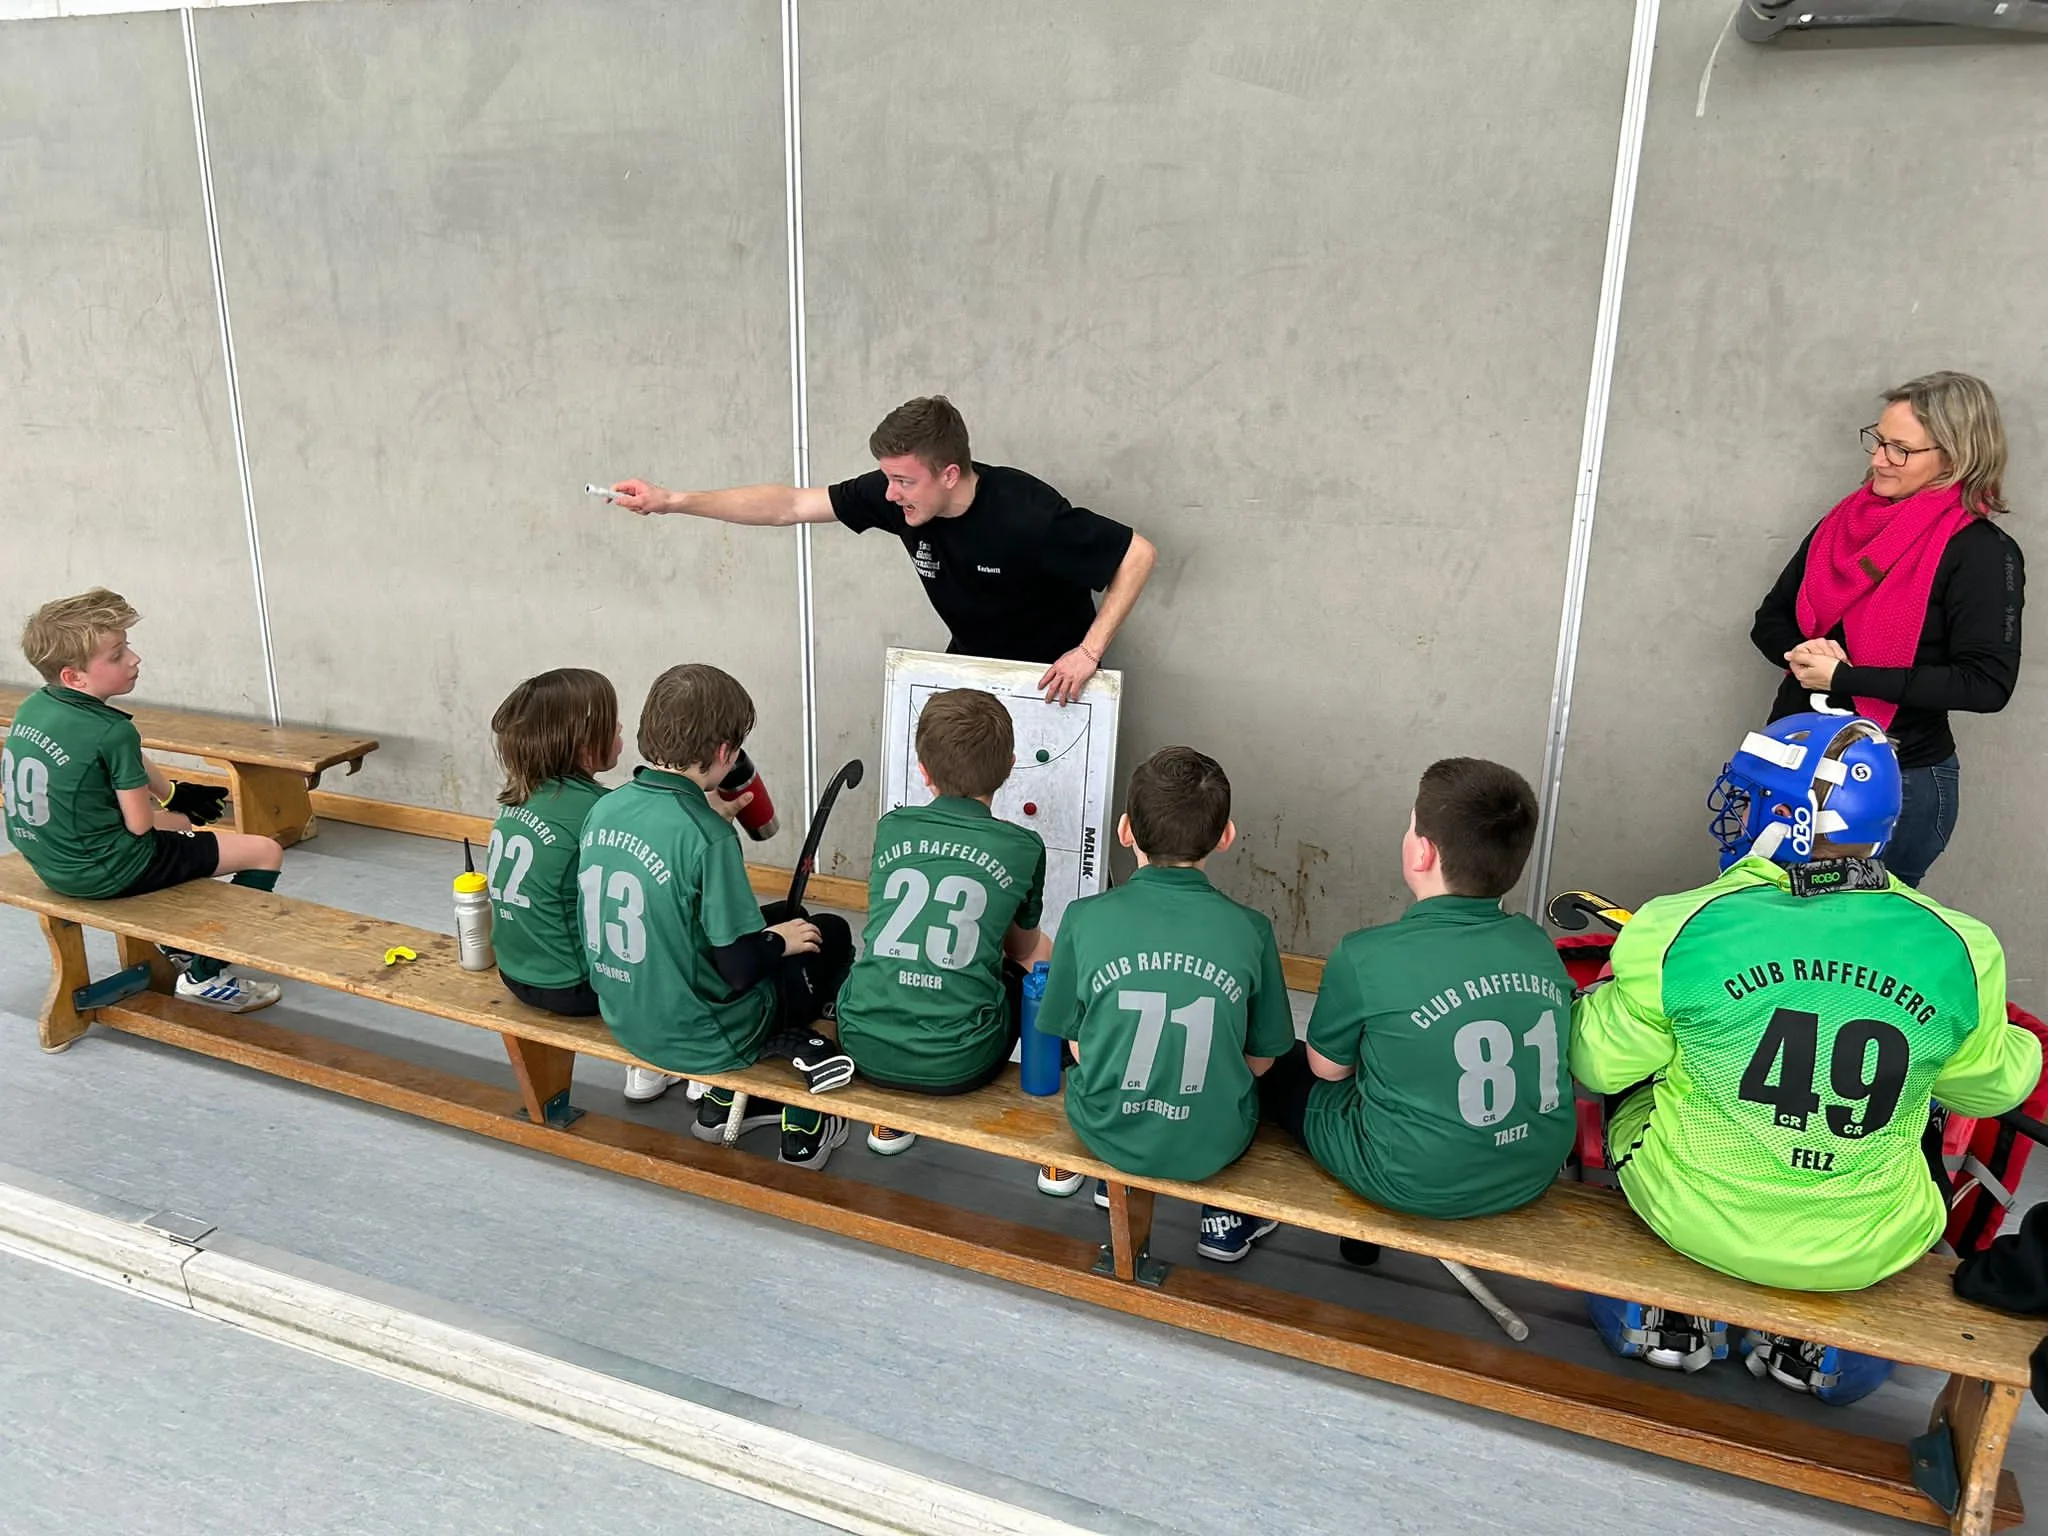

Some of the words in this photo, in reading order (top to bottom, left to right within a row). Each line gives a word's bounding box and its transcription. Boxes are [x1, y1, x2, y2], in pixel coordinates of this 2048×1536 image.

[13, 724, 70, 766] RAFFELBERG
[503, 806, 557, 846] RAFFELBERG
[1793, 807, 1811, 856] OBO
[488, 829, 534, 908] 22
[598, 828, 671, 885] RAFFELBERG
[878, 840, 912, 869] CLUB
[919, 839, 1014, 889] RAFFELBERG
[1082, 826, 1096, 878] MALIK
[1811, 872, 1841, 884] ROBO
[578, 864, 646, 964] 13
[873, 868, 988, 970] 23
[889, 948, 901, 956] CR
[943, 957, 954, 965] CR
[899, 970, 942, 990] BECKER
[1092, 956, 1132, 993] CLUB
[1138, 951, 1243, 1004] RAFFELBERG
[1411, 988, 1463, 1030] CLUB
[1464, 973, 1562, 1007] RAFFELBERG
[1724, 961, 1785, 1000] CLUB
[1793, 959, 1937, 1026] RAFFELBERG
[1118, 990, 1216, 1094] 71
[1127, 1080, 1141, 1088] CR
[1453, 1009, 1560, 1127] 81
[1738, 1007, 1910, 1139] 49
[1122, 1099, 1190, 1120] OSTERFELD
[1483, 1114, 1496, 1122] CR
[1779, 1114, 1801, 1127] CR
[1843, 1124, 1862, 1135] CR
[1494, 1123, 1528, 1146] TAETZ
[1791, 1147, 1835, 1172] FELZ
